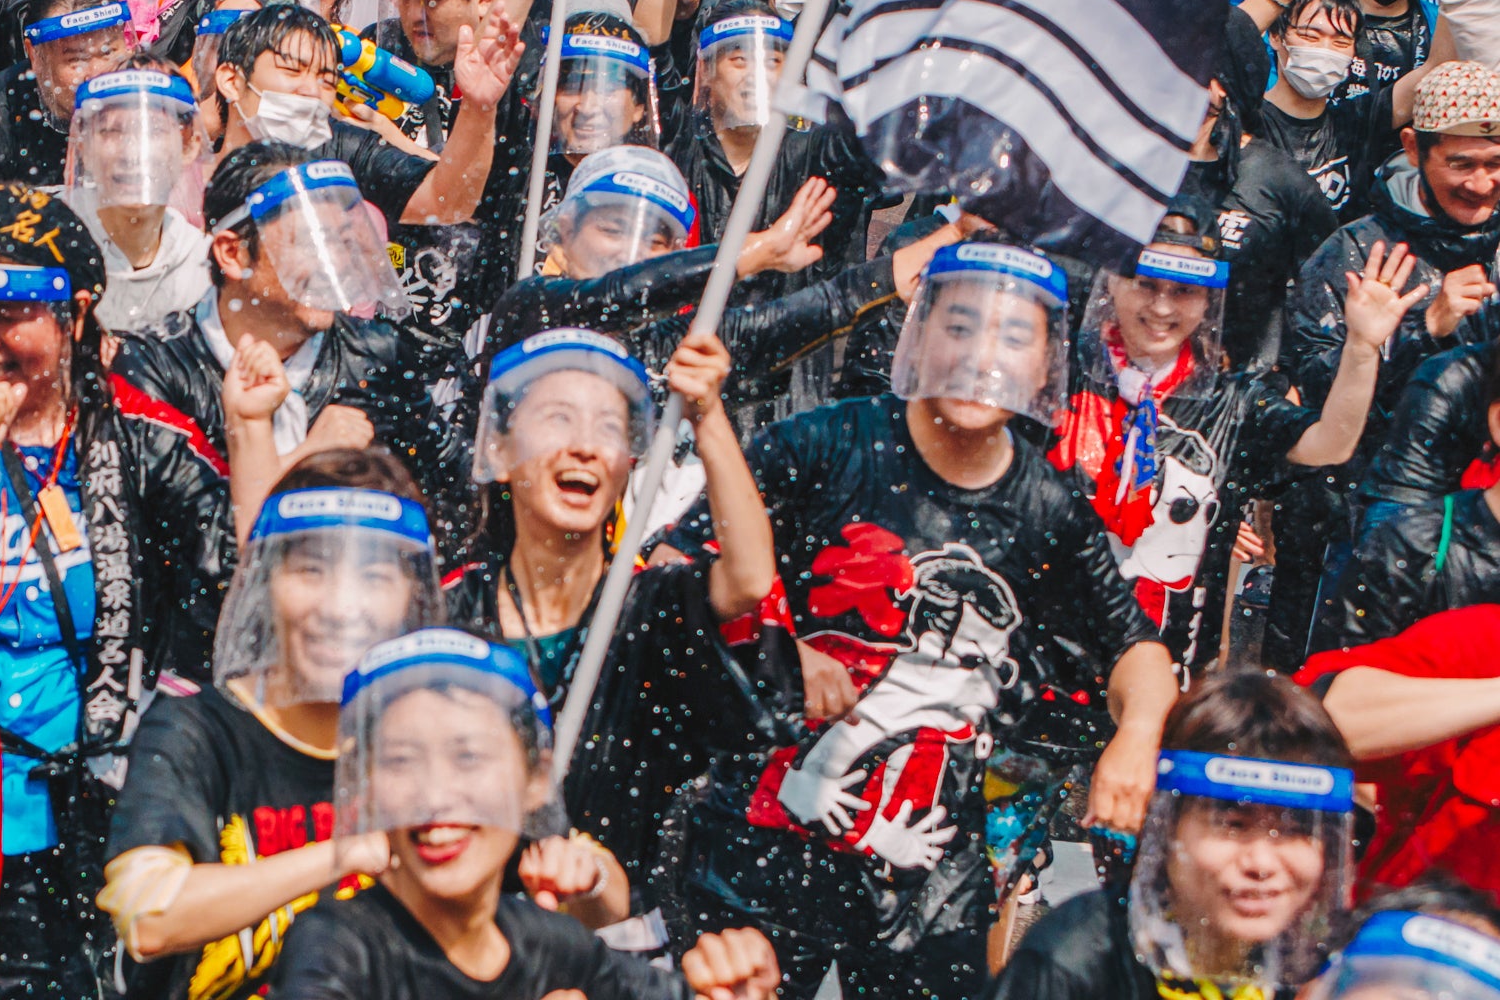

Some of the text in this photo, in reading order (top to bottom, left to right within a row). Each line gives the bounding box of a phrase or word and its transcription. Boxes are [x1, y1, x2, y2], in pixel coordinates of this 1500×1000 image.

[66, 6, 120, 25] Face Shield
[575, 38, 635, 52] Face Shield
[1142, 254, 1211, 273] Face Shield
[84, 439, 133, 723] 別府八湯温泉道名人会
